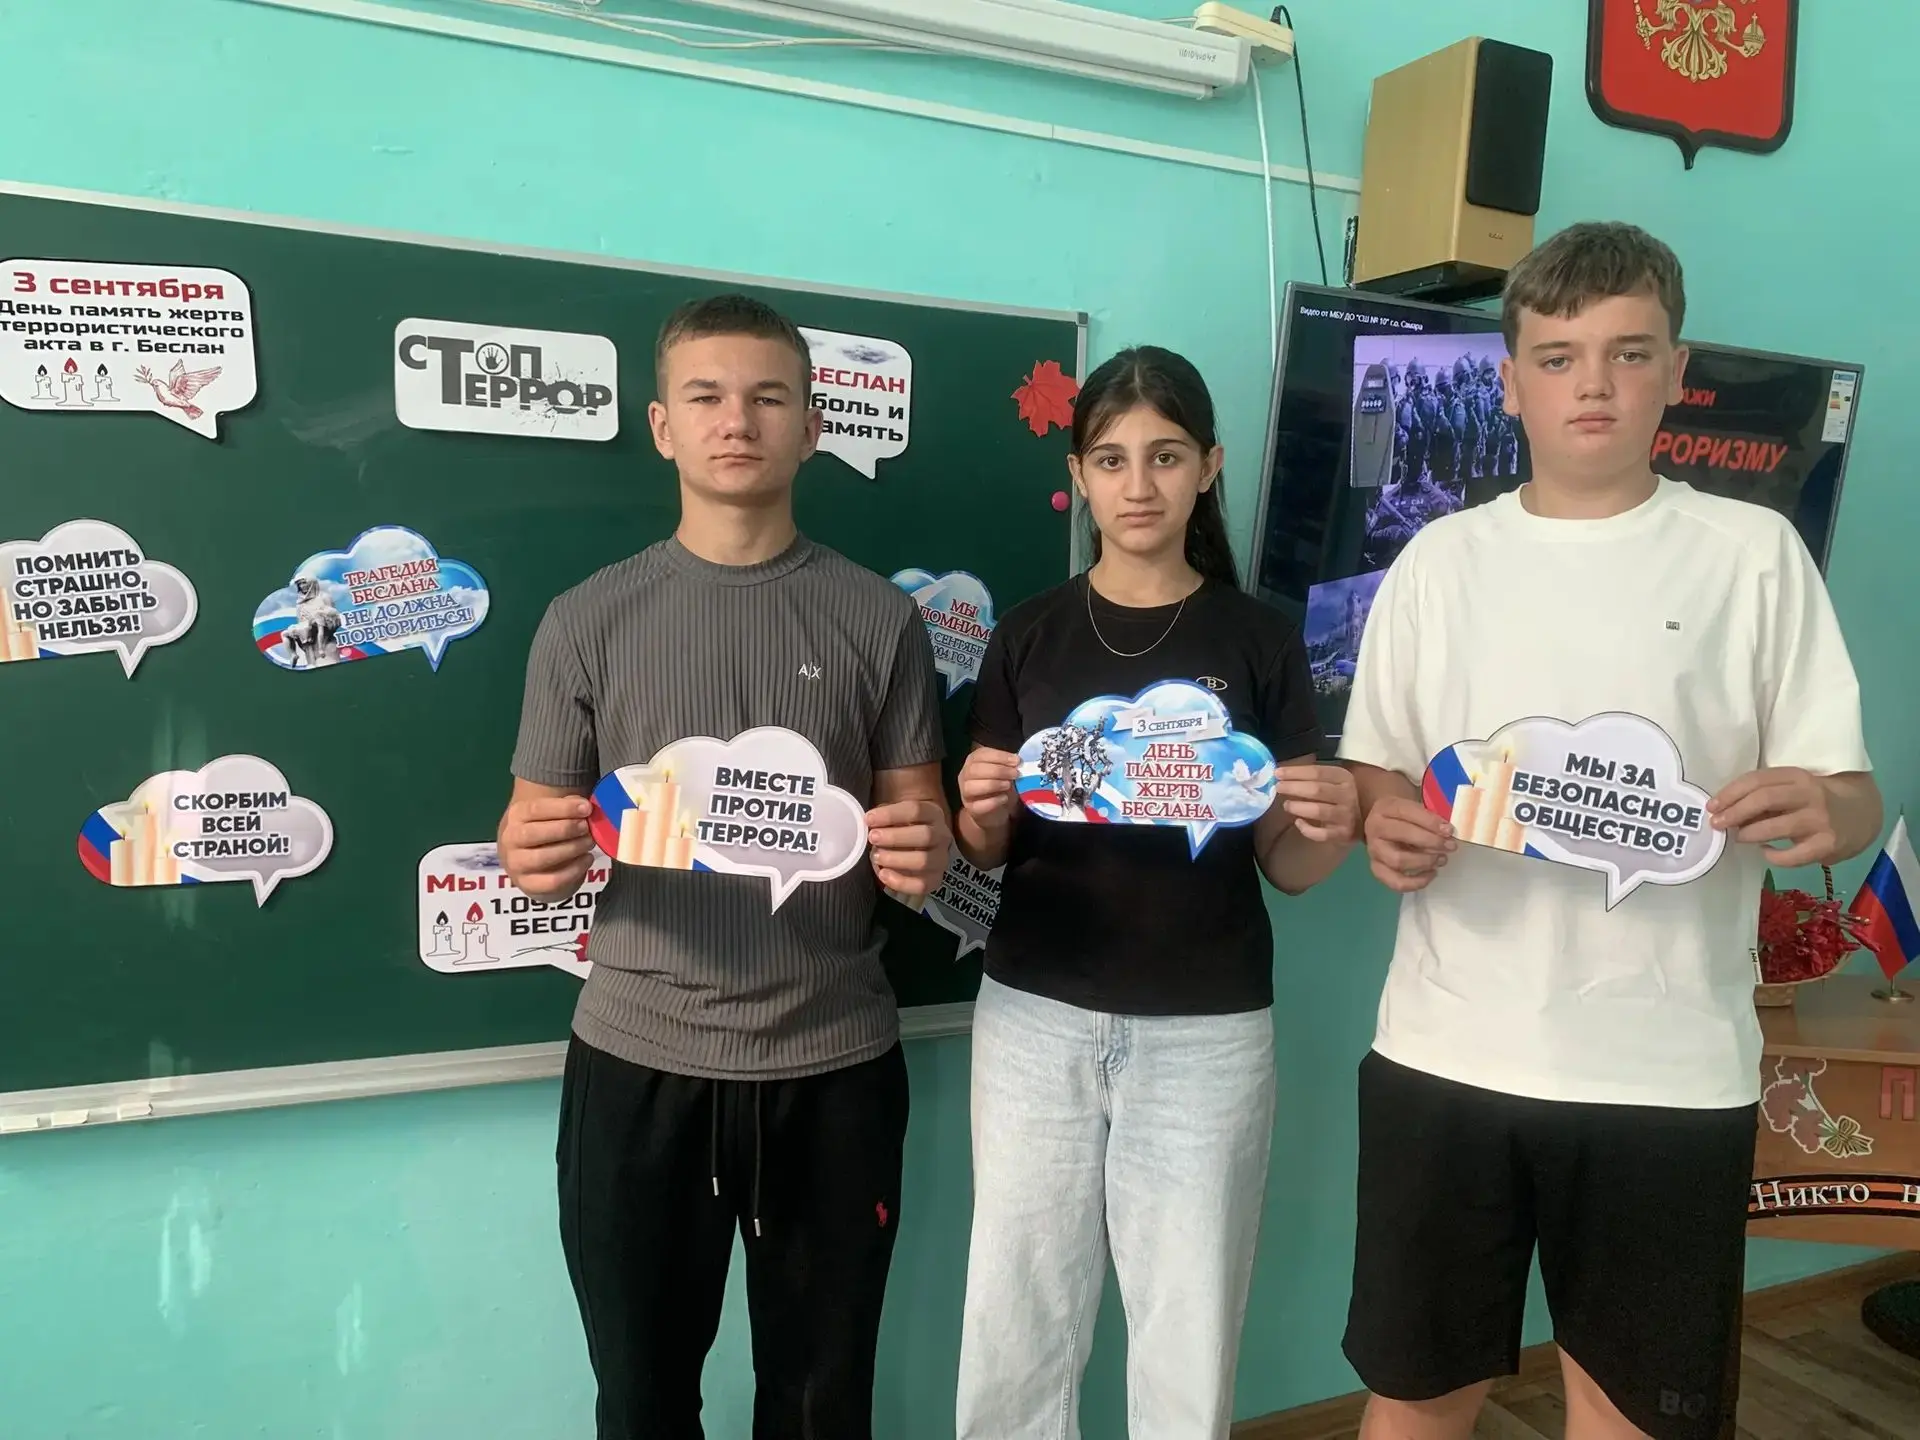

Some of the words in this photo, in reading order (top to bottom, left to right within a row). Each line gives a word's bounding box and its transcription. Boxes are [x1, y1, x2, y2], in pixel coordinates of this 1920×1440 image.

[13, 271, 36, 292] 3
[50, 278, 224, 302] сентября
[0, 300, 62, 316] День
[70, 305, 161, 319] память
[169, 308, 244, 323] жертв
[1300, 306, 1320, 316] Видео
[1329, 310, 1344, 319] МБУ
[1344, 312, 1355, 322] ДО
[0, 320, 244, 338] террористического
[24, 339, 81, 351] акта
[91, 340, 104, 351] в
[113, 341, 129, 352] г.
[137, 339, 224, 354] Беслан
[811, 393, 880, 417] боль
[889, 406, 904, 420] и
[822, 420, 904, 442] амять
[1652, 431, 1788, 472] РОРИЗМУ
[16, 550, 140, 575] ПОМНИТЬ
[344, 558, 438, 587] ТРАГЕДИЯ
[16, 571, 148, 597] СТРАШНО,
[352, 577, 439, 604] БЕСЛАНА
[14, 601, 52, 620] НО
[58, 592, 157, 616] ЗАБЫТЬ
[343, 608, 371, 627] НЕ
[376, 594, 459, 620] ДОЛЖНА
[950, 598, 979, 618] МЫ
[39, 615, 140, 640] НЕЛЬЗЯ!
[335, 607, 474, 647] ПОВТОРИТЬСЯ!
[933, 645, 949, 660] 004
[934, 631, 985, 656] СЕНТЯБР
[1137, 718, 1146, 733] 3
[1149, 717, 1202, 732] СЕНТЯБРЯ
[1143, 744, 1195, 761] ДЕНЬ
[715, 767, 815, 796] ВМЕСТЕ
[1125, 762, 1212, 780] ПАМЯТИ
[1565, 752, 1616, 781] МЫ
[1621, 764, 1656, 790] ЗА
[174, 791, 287, 811] СКОРБИМ
[1136, 783, 1199, 799] ЖЕРТВ
[1512, 771, 1702, 829] БЕЗОПАСНОЕ
[710, 794, 812, 823] ПРОТИВ
[1121, 801, 1215, 819] БЕСЛАНА
[202, 811, 261, 834] ВСЕЙ
[1515, 803, 1687, 856] ОБЩЕСТВО!
[173, 833, 289, 858] СТРАНОЙ!
[698, 821, 818, 851] ТЕРРОРА!
[952, 858, 971, 879] ЗА
[427, 874, 485, 893] Мы
[930, 886, 946, 902] А
[511, 914, 589, 936] БЕСЛ
